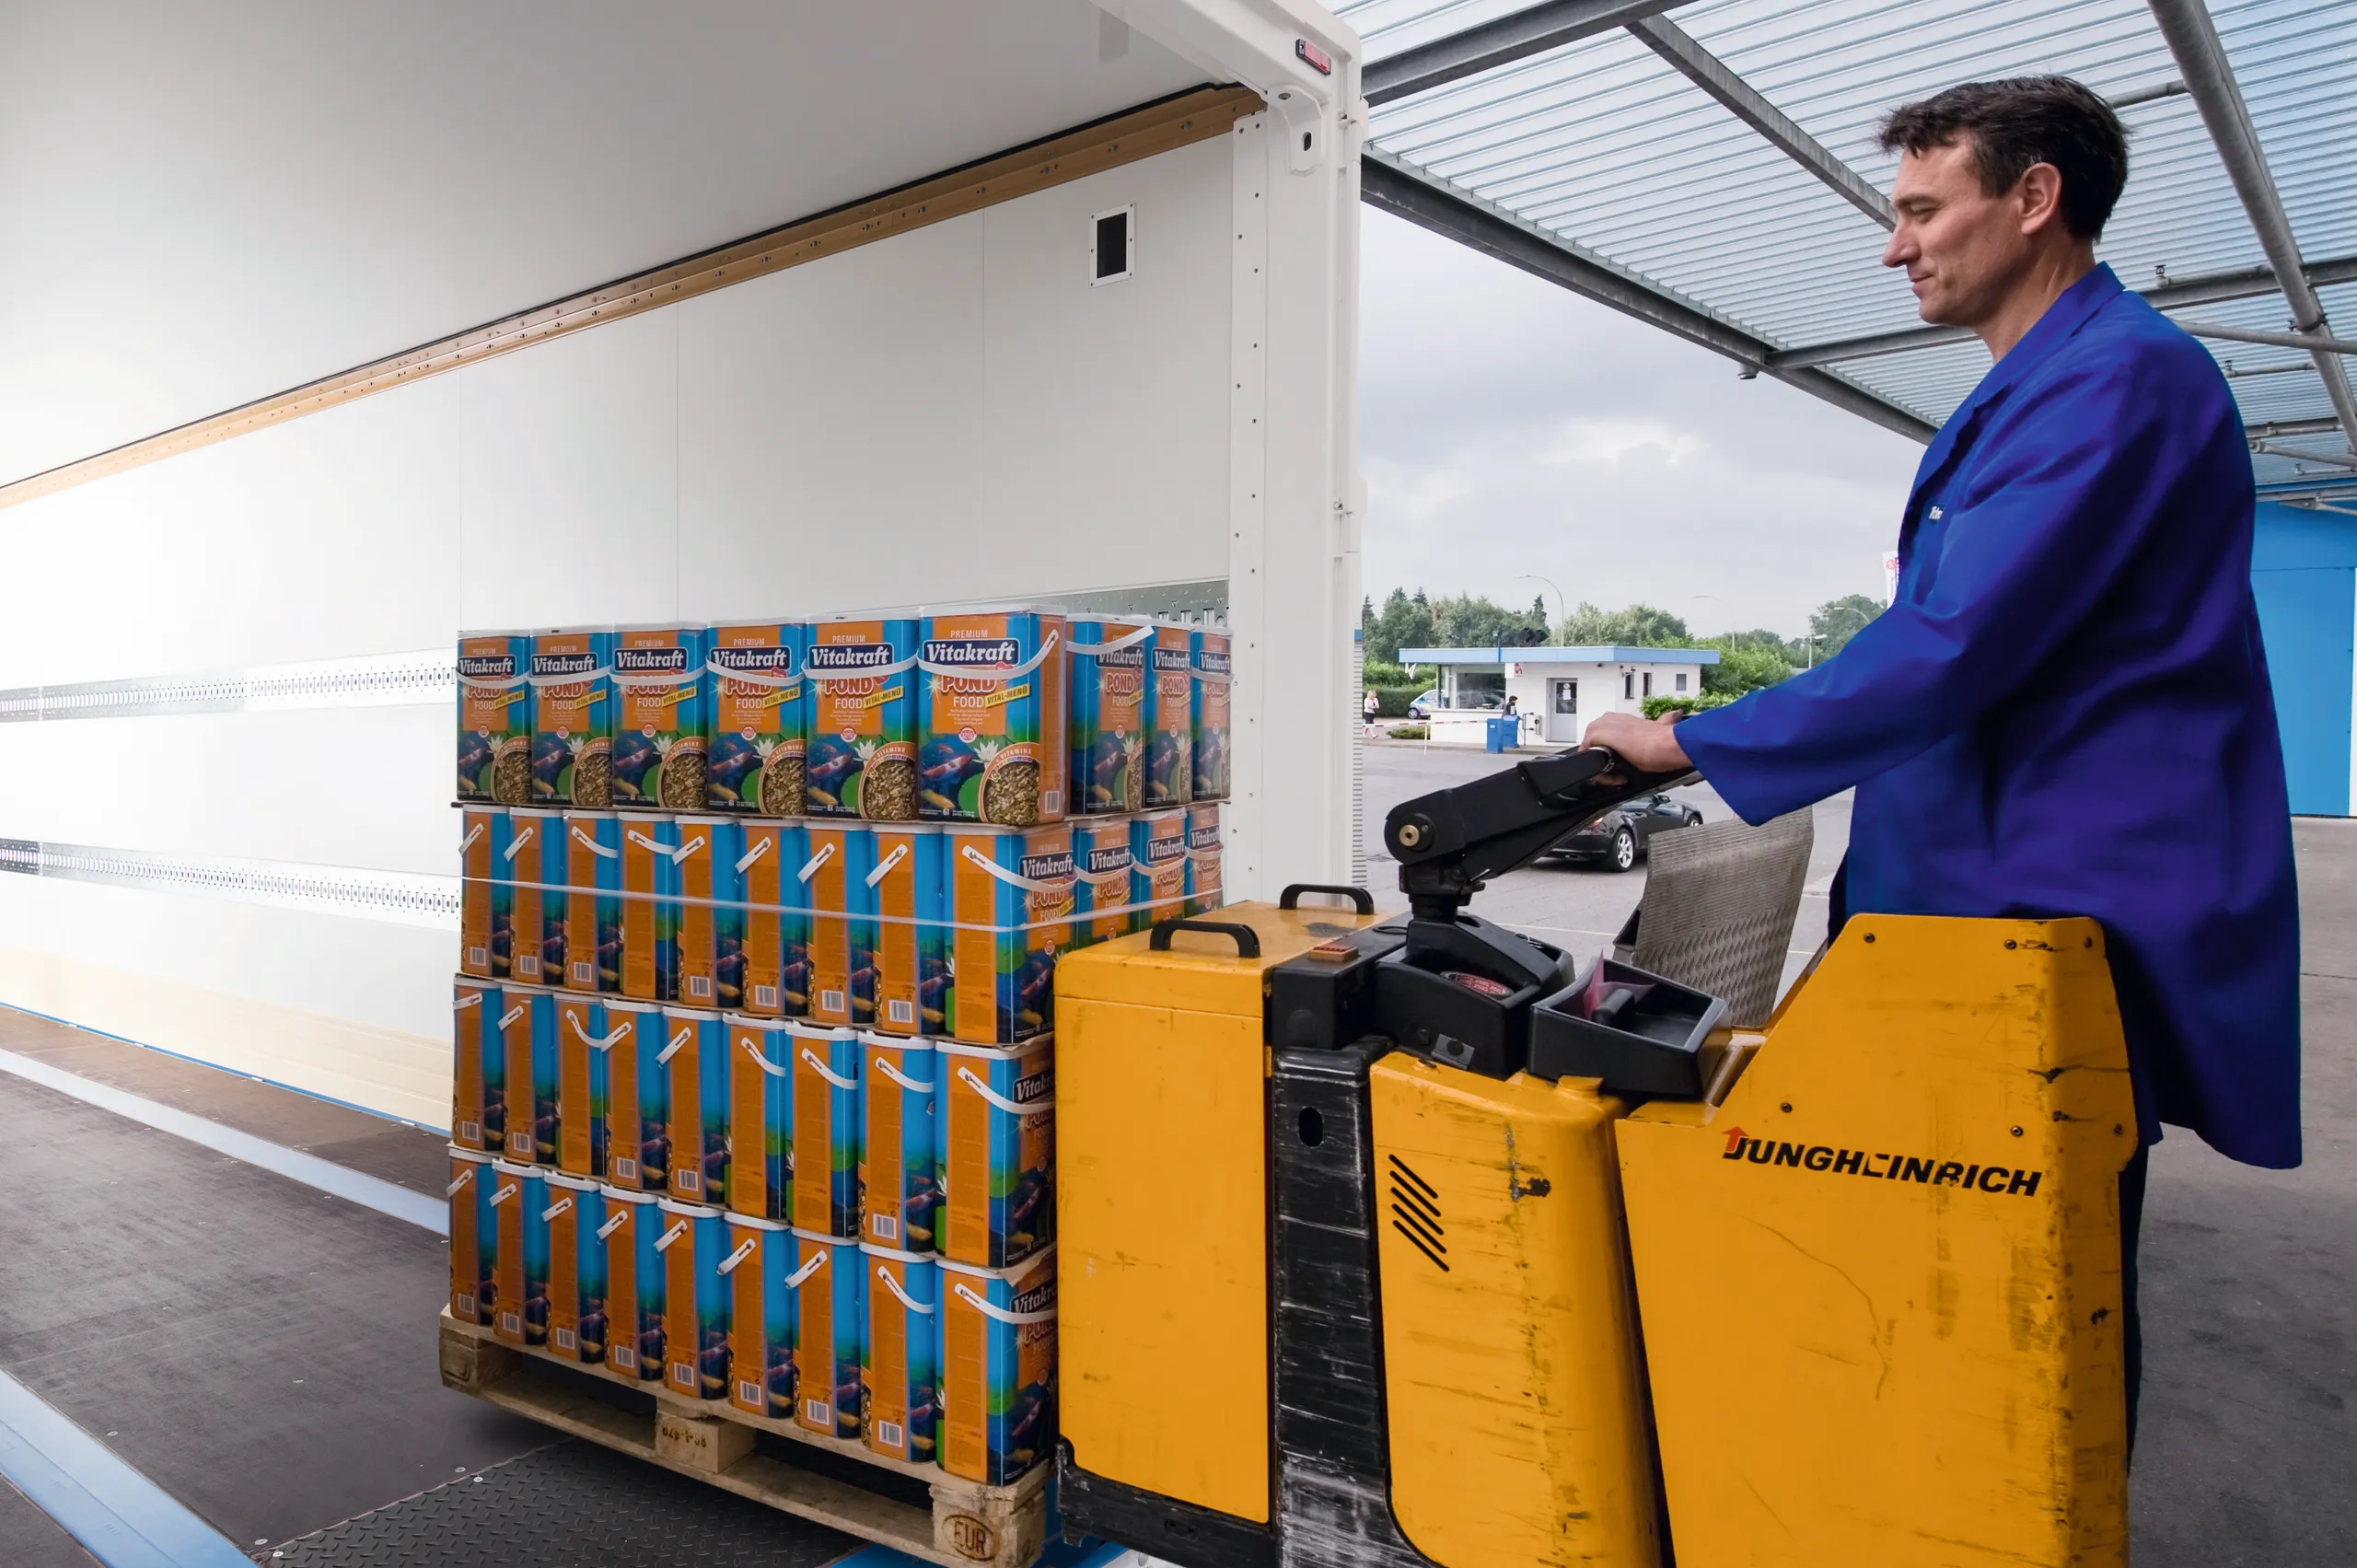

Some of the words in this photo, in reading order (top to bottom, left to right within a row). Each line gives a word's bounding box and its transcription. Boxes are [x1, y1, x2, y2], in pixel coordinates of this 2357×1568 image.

[733, 638, 765, 646] PREMIUM
[832, 634, 865, 644] PREMIUM
[950, 630, 988, 638] PREMIUM
[617, 649, 684, 668] Vitakraft
[714, 648, 787, 668] Vitakraft
[811, 646, 889, 666] Vitakraft
[927, 642, 1016, 662] Vitakraft
[1155, 650, 1190, 668] Vitakraft
[459, 657, 514, 674] Vitakraft
[533, 653, 595, 672] Vitakraft
[1201, 654, 1230, 670] Vitakraft
[825, 677, 874, 695] POND
[1106, 672, 1134, 694] POND
[1162, 676, 1186, 696] POND
[637, 698, 660, 707] FOOD
[737, 699, 762, 709] FOOD
[835, 698, 863, 709] FOOD
[953, 696, 984, 708] FOOD
[877, 747, 905, 759] VITAMINE
[1001, 748, 1032, 760] VITAMINE
[1150, 837, 1185, 859] Vitakraft
[1022, 854, 1074, 877] Vitakraft
[1090, 847, 1131, 870] Vitakraft
[954, 1520, 986, 1556] EUR
